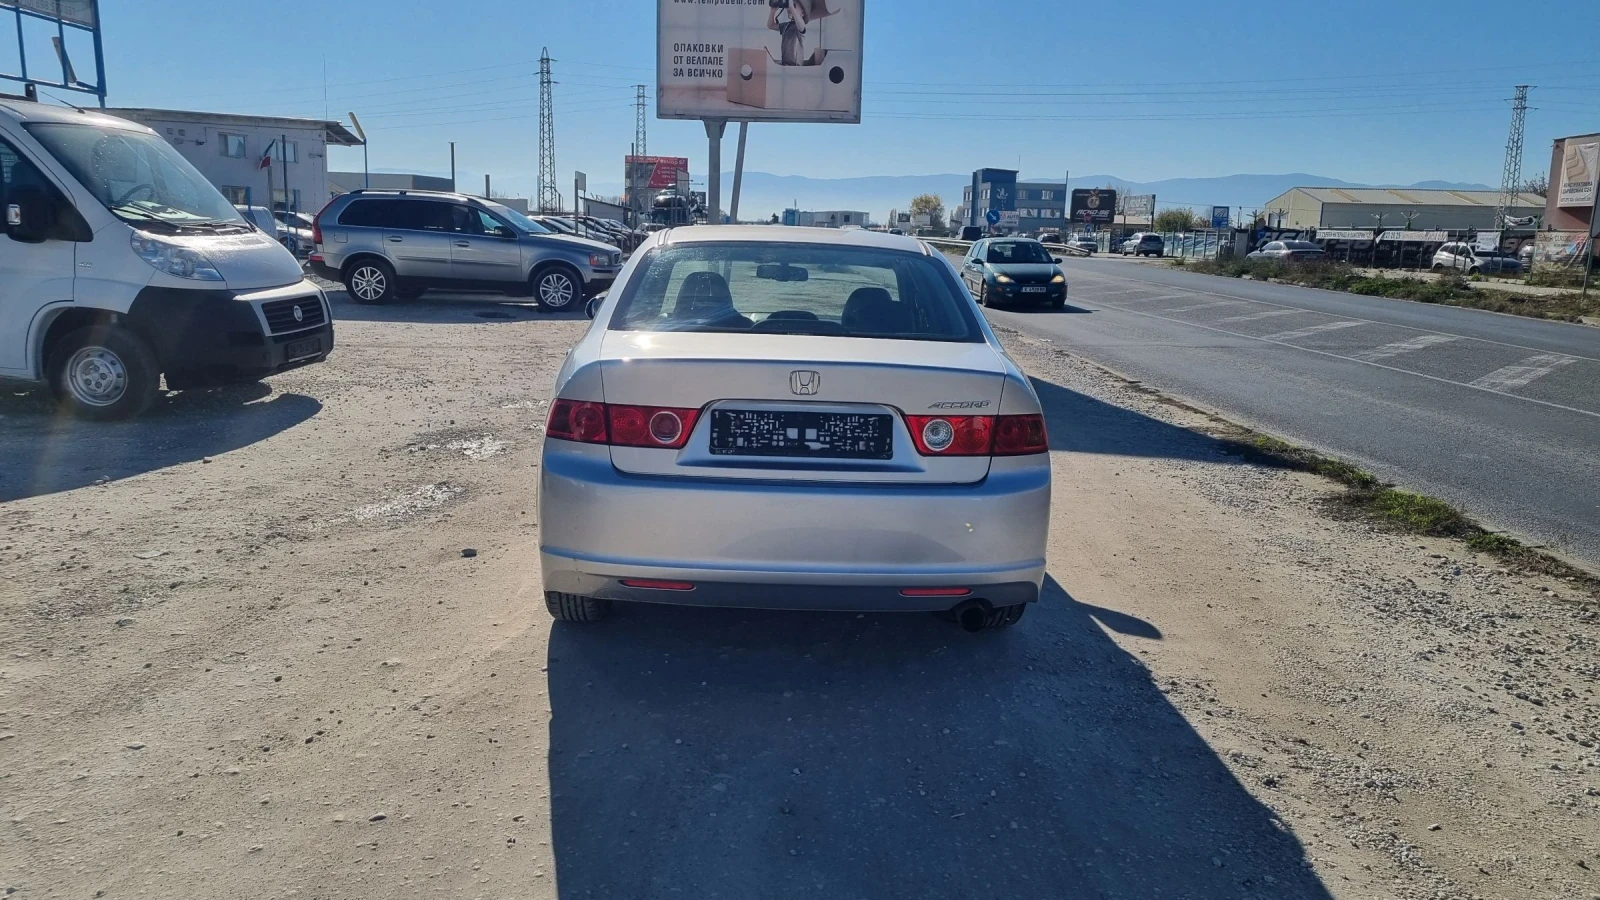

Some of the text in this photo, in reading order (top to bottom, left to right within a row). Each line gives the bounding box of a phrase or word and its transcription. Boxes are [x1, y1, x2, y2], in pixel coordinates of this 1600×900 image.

[674, 43, 724, 53] ОПАКОВКИ
[673, 55, 723, 66] ОТ ВЕЛПАПЕ
[673, 68, 723, 78] ЗА ВСИЧКО
[928, 400, 991, 409] ACCORD
